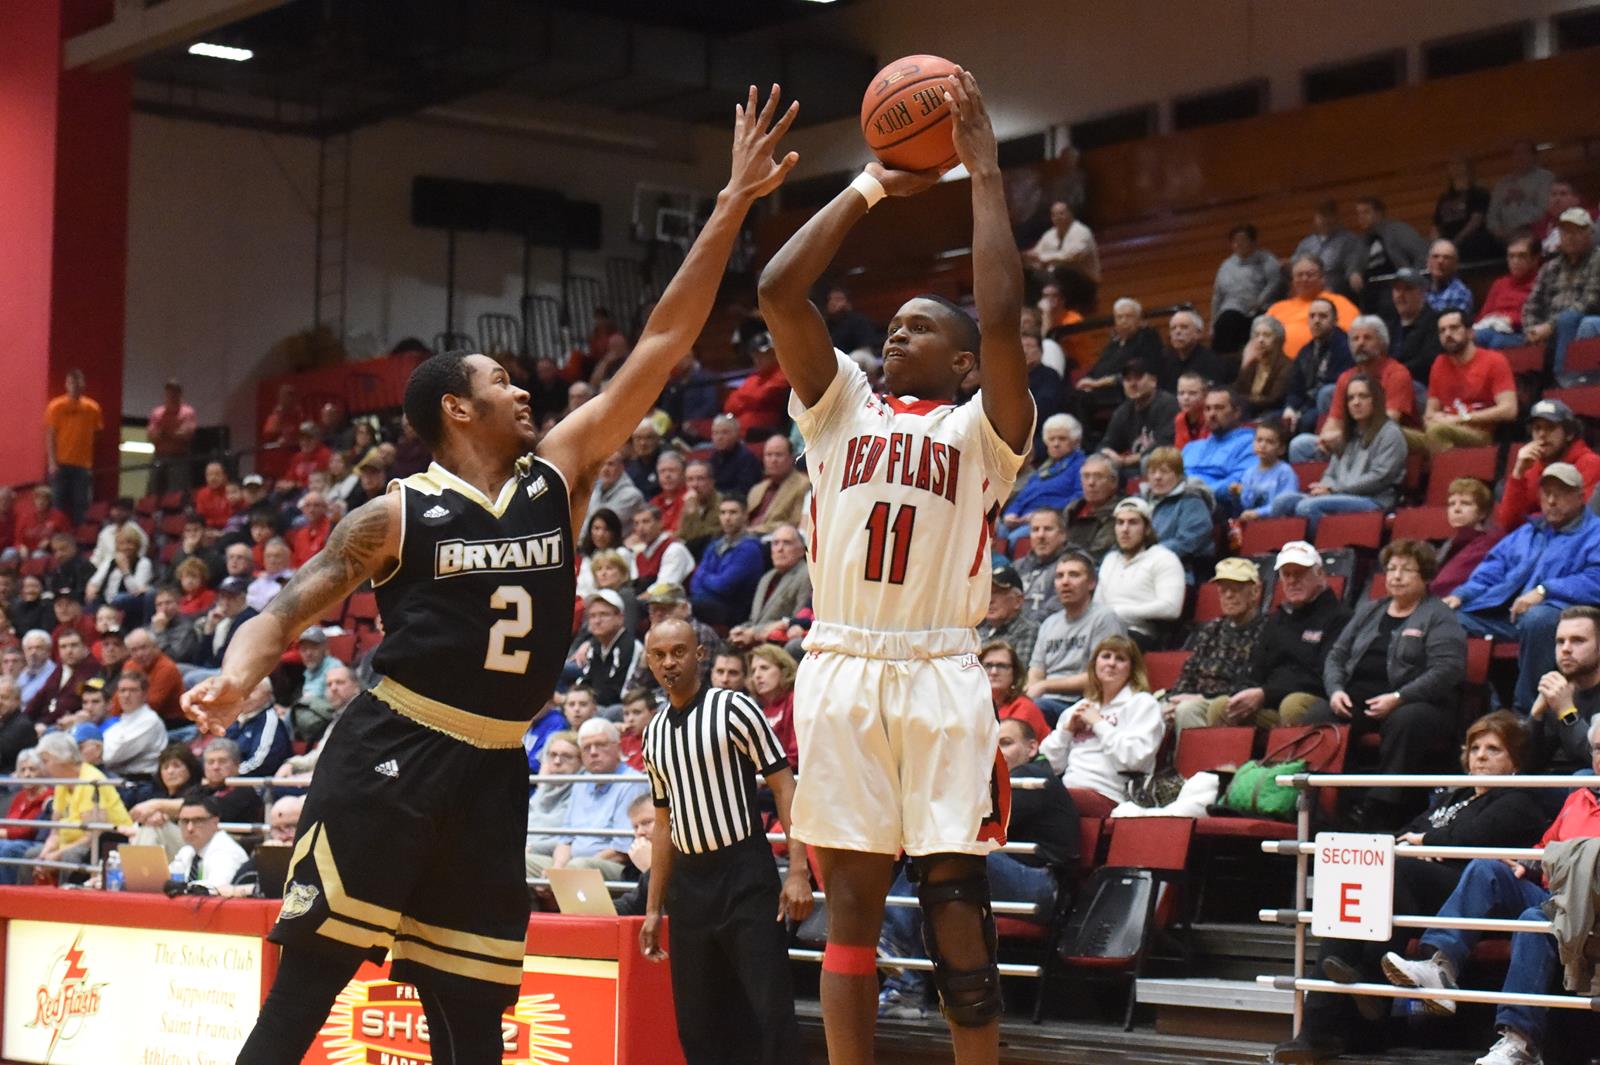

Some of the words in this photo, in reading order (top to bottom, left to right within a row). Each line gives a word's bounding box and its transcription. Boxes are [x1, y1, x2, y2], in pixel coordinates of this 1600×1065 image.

[874, 101, 914, 135] ROCK
[438, 534, 561, 575] BRYANT
[864, 501, 917, 585] 11
[483, 585, 533, 675] 2
[1322, 848, 1384, 866] SECTION
[1340, 882, 1362, 923] E
[155, 943, 177, 965] The
[222, 947, 254, 971] Club
[34, 986, 61, 1026] Red
[57, 983, 101, 1024] Flash
